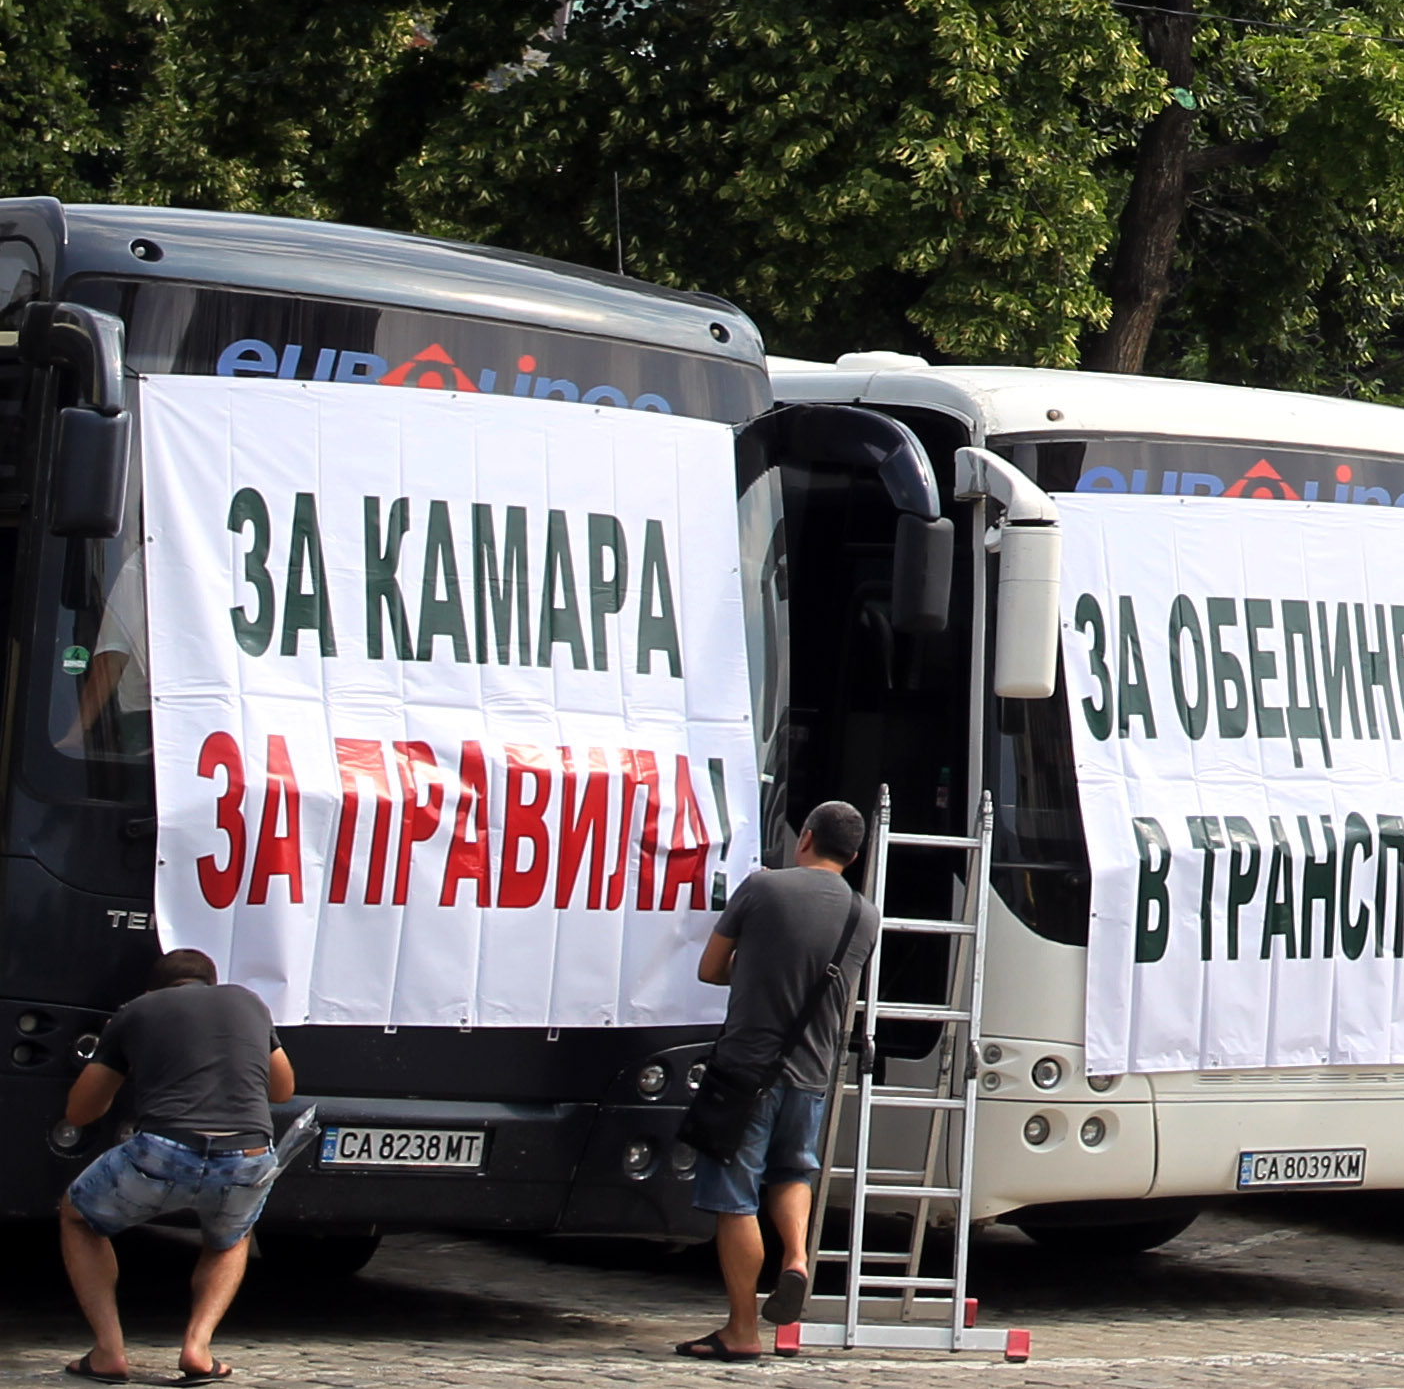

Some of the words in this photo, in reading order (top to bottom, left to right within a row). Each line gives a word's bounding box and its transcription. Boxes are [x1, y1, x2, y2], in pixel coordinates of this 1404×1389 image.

[228, 487, 338, 657] ЗА
[364, 495, 684, 678] КАМАРА
[1075, 593, 1158, 741] ЗА
[197, 731, 304, 909] ЗА
[328, 738, 732, 911] ПРАВИЛА!
[1132, 817, 1172, 963] В
[340, 1132, 373, 1159] CA
[379, 1134, 441, 1160] 8238
[445, 1135, 480, 1161] MT
[1254, 1157, 1279, 1180] CA
[1284, 1156, 1331, 1179] 8039
[1334, 1154, 1361, 1178] KM
